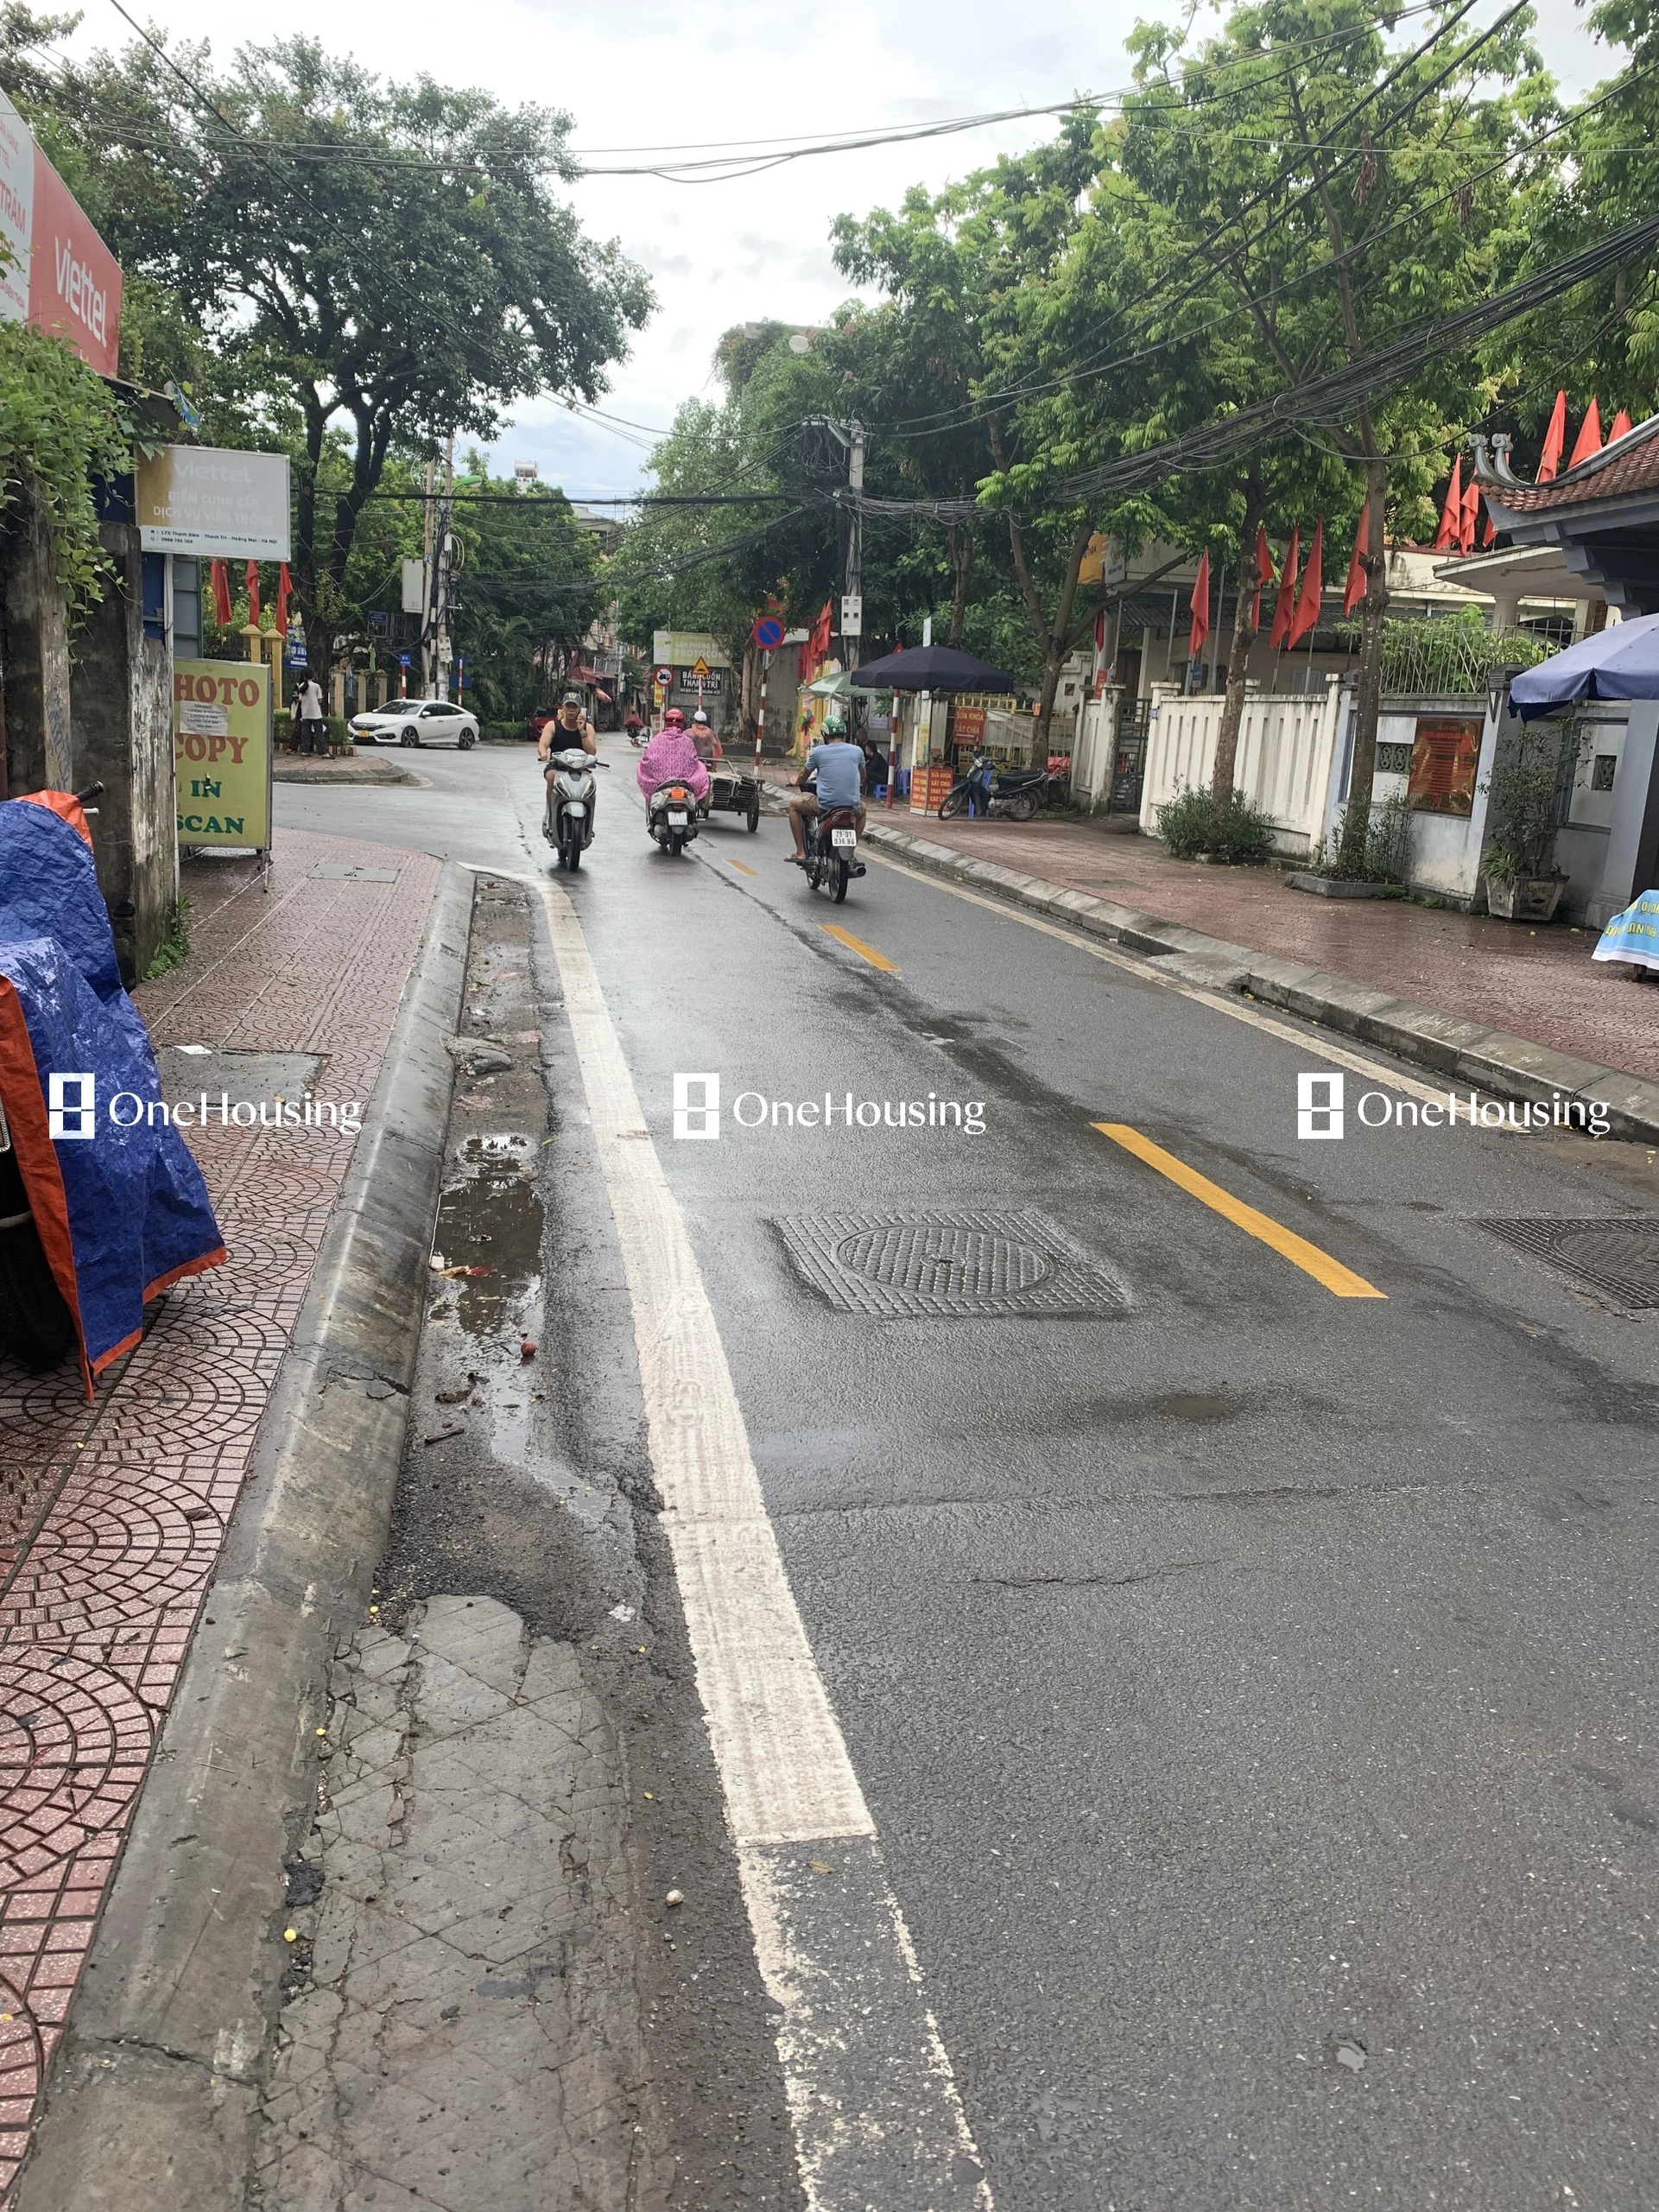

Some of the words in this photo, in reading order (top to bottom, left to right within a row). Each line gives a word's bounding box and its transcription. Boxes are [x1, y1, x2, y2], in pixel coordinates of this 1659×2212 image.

[153, 505, 181, 518] DỊCH
[174, 674, 260, 707] HOTO
[190, 780, 222, 798] IN
